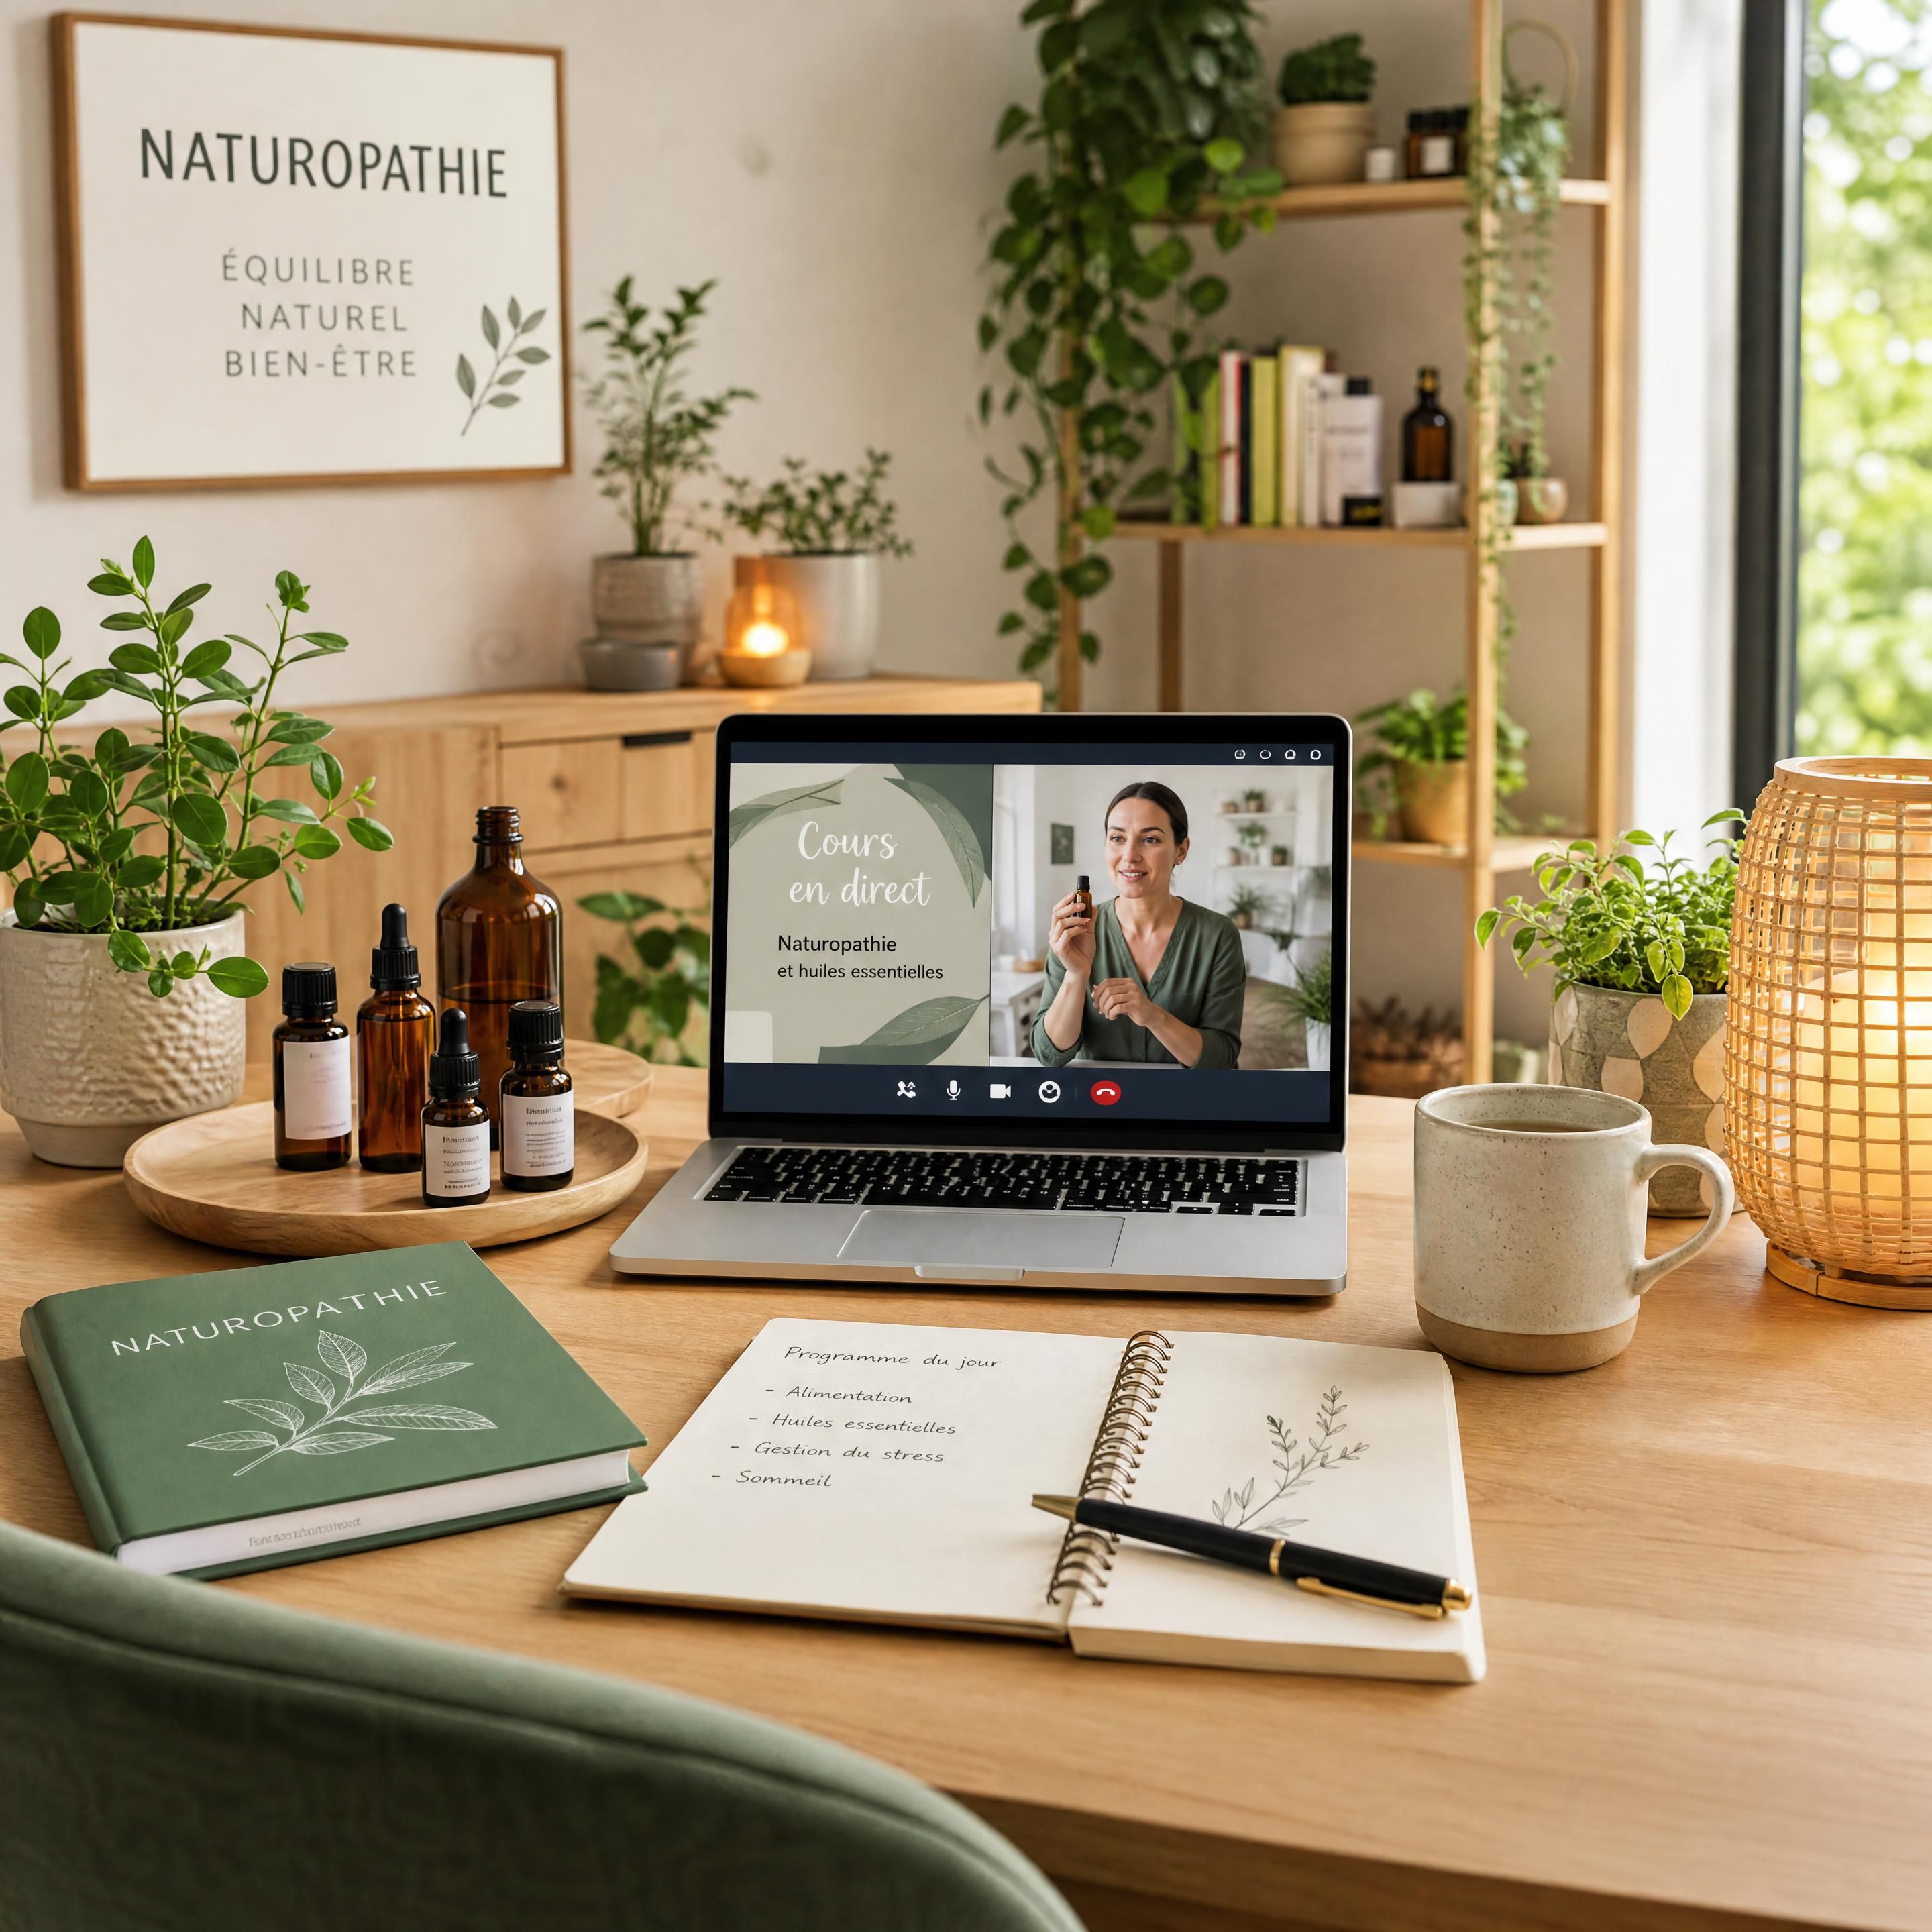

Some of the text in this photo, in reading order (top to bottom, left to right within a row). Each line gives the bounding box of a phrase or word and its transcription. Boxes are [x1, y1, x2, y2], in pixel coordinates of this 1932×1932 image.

[141, 128, 507, 198] NATUROPATHIE
[222, 248, 413, 286] ÉQUILIBRE
[241, 303, 407, 331] NATUREL
[225, 343, 415, 377] BIEN-ÊTRE
[798, 821, 898, 860] Cours
[789, 867, 932, 907] en direct
[778, 935, 897, 956] Naturopathie
[777, 963, 943, 979] et huiles essentielles
[111, 1279, 447, 1356] NATUROPATHIE
[784, 1346, 1002, 1371] Programme du jour
[786, 1385, 912, 1403] Alimentation
[772, 1413, 833, 1428] Huiles
[844, 1420, 956, 1434] essentielles
[755, 1441, 832, 1456] Gestion
[843, 1446, 870, 1458] du
[881, 1448, 944, 1462] stress
[735, 1470, 832, 1487] Sommeil
